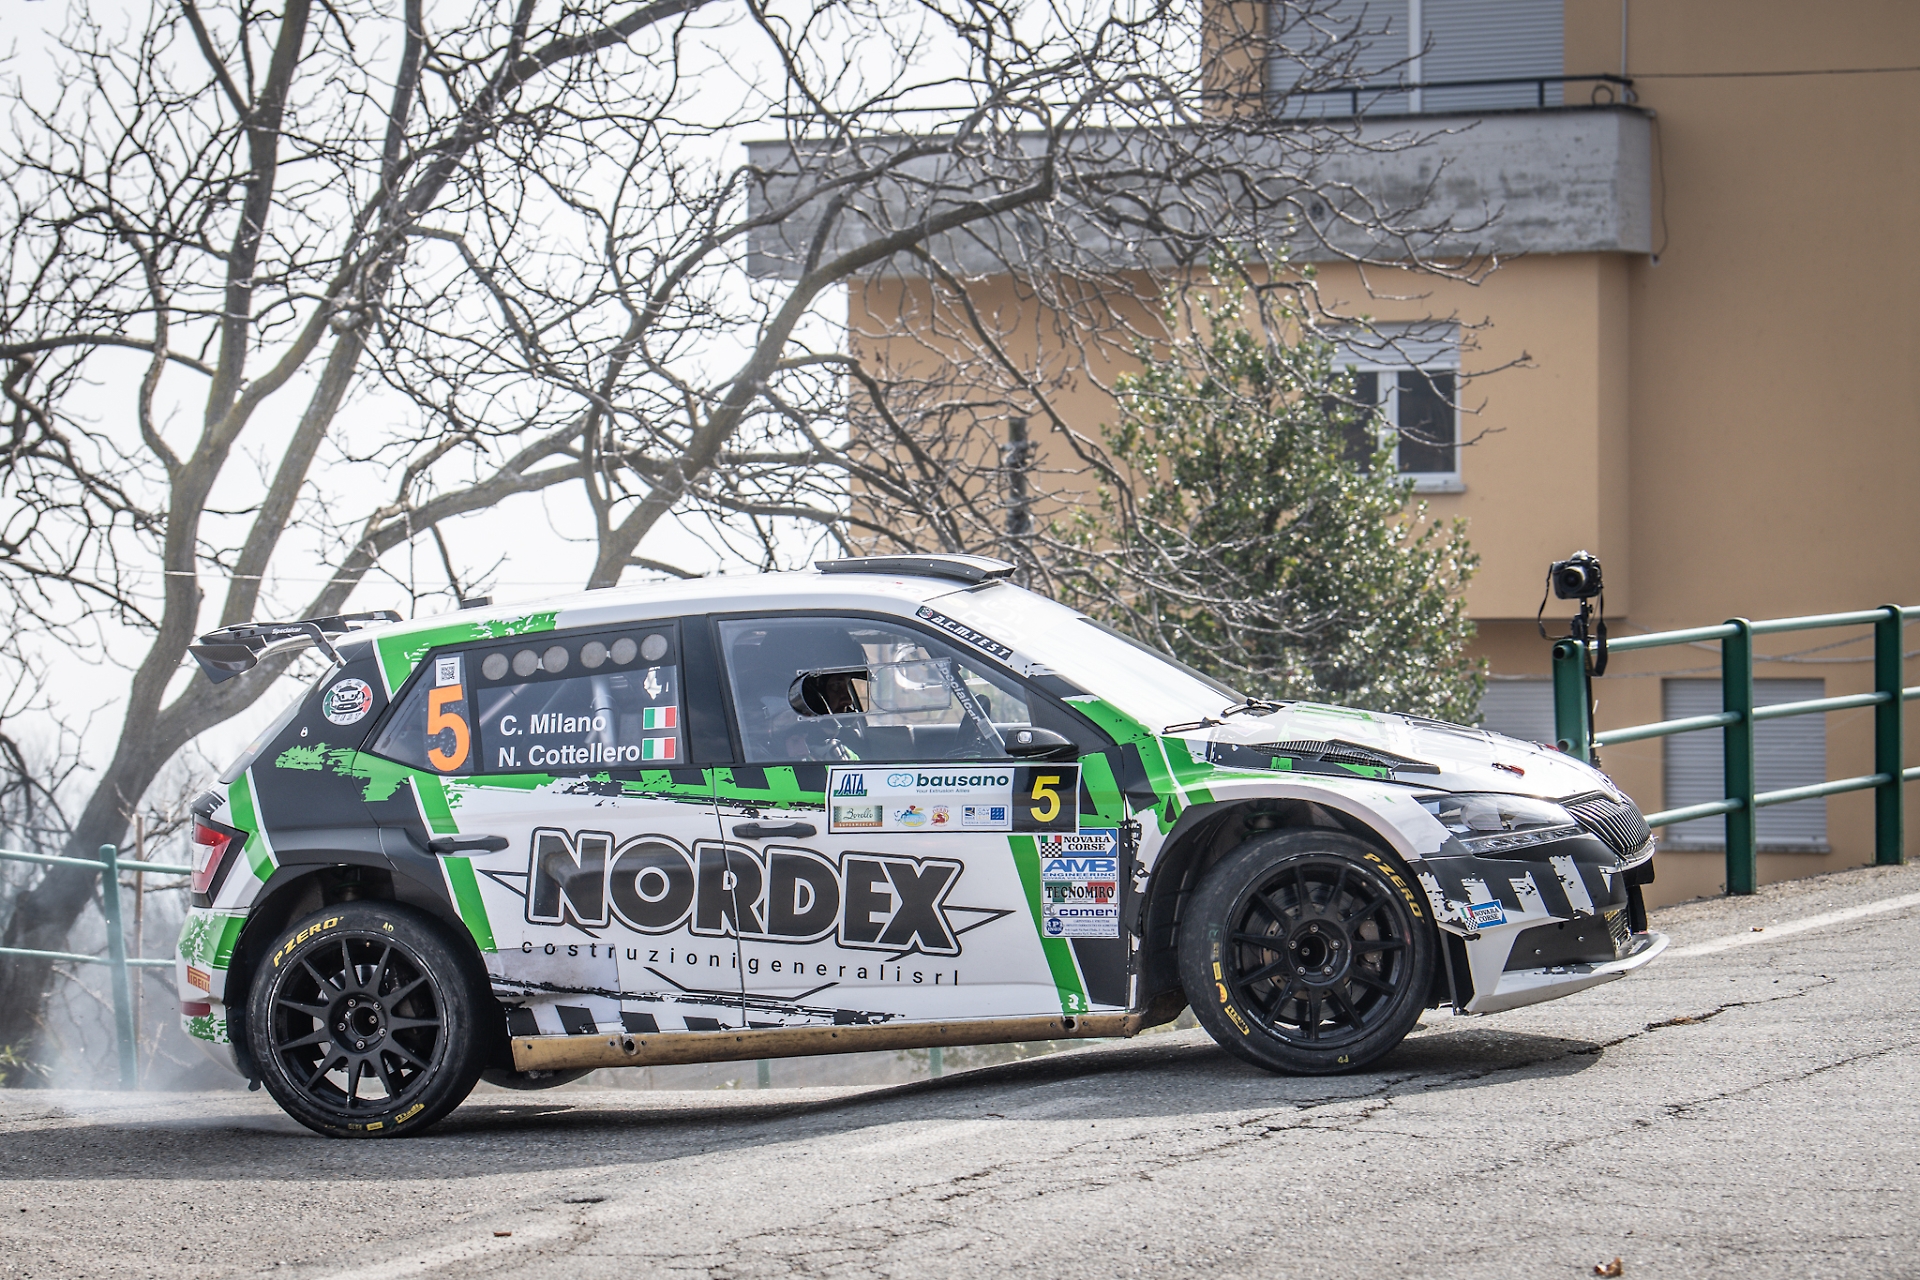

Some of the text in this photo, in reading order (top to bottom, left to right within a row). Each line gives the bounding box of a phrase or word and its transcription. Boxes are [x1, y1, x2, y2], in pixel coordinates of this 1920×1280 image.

[427, 684, 470, 772] 5
[499, 712, 607, 736] C. Milano
[498, 742, 639, 767] N. Cottellero
[837, 773, 864, 795] SATA
[916, 773, 1009, 787] bausano
[1029, 775, 1061, 823] 5
[1068, 843, 1106, 851] CORSE
[1043, 859, 1116, 872] AMB
[525, 826, 965, 957] NORDEX
[1046, 886, 1114, 899] TECNOMIRO
[1059, 904, 1117, 916] comeri
[522, 940, 960, 986] costruzionigeneralisrl
